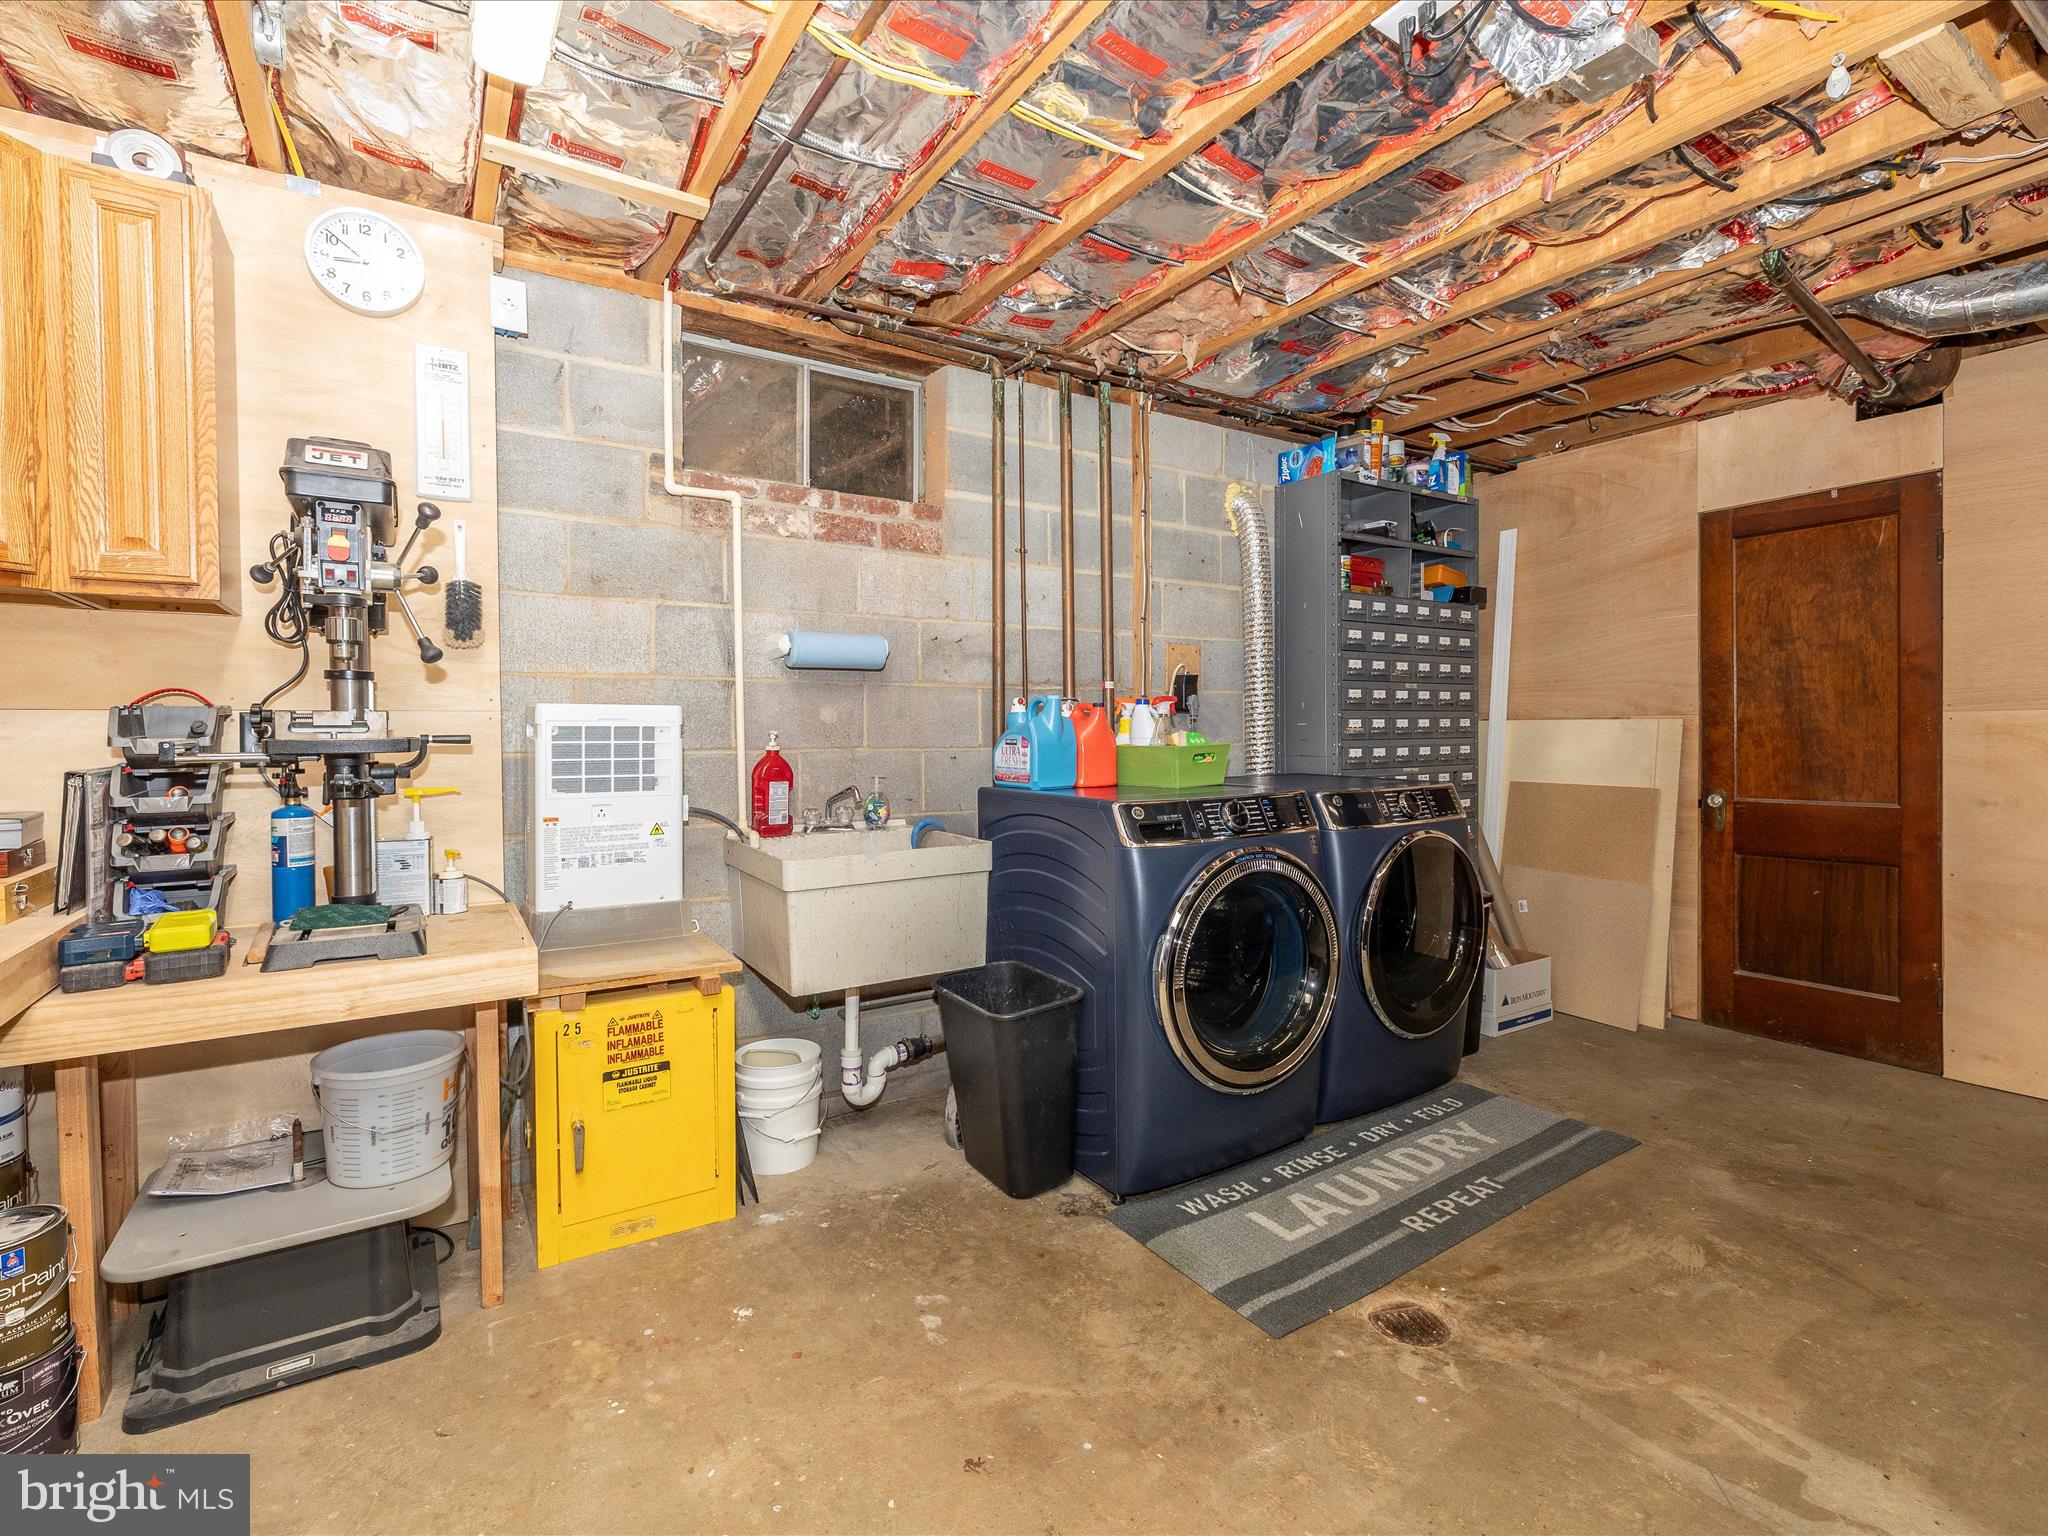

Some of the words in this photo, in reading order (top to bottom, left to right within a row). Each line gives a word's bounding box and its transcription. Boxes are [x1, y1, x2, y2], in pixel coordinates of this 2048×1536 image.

[342, 224, 348, 235] 11
[359, 223, 371, 236] 12
[325, 233, 339, 246] 10
[384, 232, 387, 244] 1
[396, 247, 405, 259] 2
[326, 267, 336, 279] 8
[342, 282, 351, 293] 7
[362, 291, 371, 302] 6
[312, 452, 362, 465] JET
[1281, 456, 1291, 482] Ziploc
[1001, 746, 1020, 757] ULTRA
[607, 1019, 664, 1038] FLAMMABLE
[607, 1032, 664, 1052] INFLAMABLE
[607, 1045, 665, 1065] INFLAMMABLE
[621, 1063, 660, 1078] JUSTRITE
[616, 1077, 643, 1089] FLAMMABLE
[643, 1075, 658, 1085] LIQUID
[618, 1084, 638, 1095] STORAGE
[639, 1082, 657, 1091] CABINET
[1176, 1180, 1259, 1216] WASH
[1273, 1146, 1349, 1180] RINSE
[1358, 1121, 1403, 1145] DRY
[1413, 1097, 1465, 1121] FOLD
[1244, 1120, 1501, 1243] LAUNDRY
[1400, 1175, 1505, 1234] REPEAT
[7, 1301, 20, 1310] AND
[20, 1291, 43, 1305] PRIMER
[5, 1320, 39, 1336] ACRYLIC
[39, 1308, 58, 1323] LATEX
[1, 1332, 25, 1344] LIMITED
[25, 1317, 52, 1335] WARRANTY
[6, 1355, 28, 1368] GLOSS
[1, 1386, 19, 1398] UM
